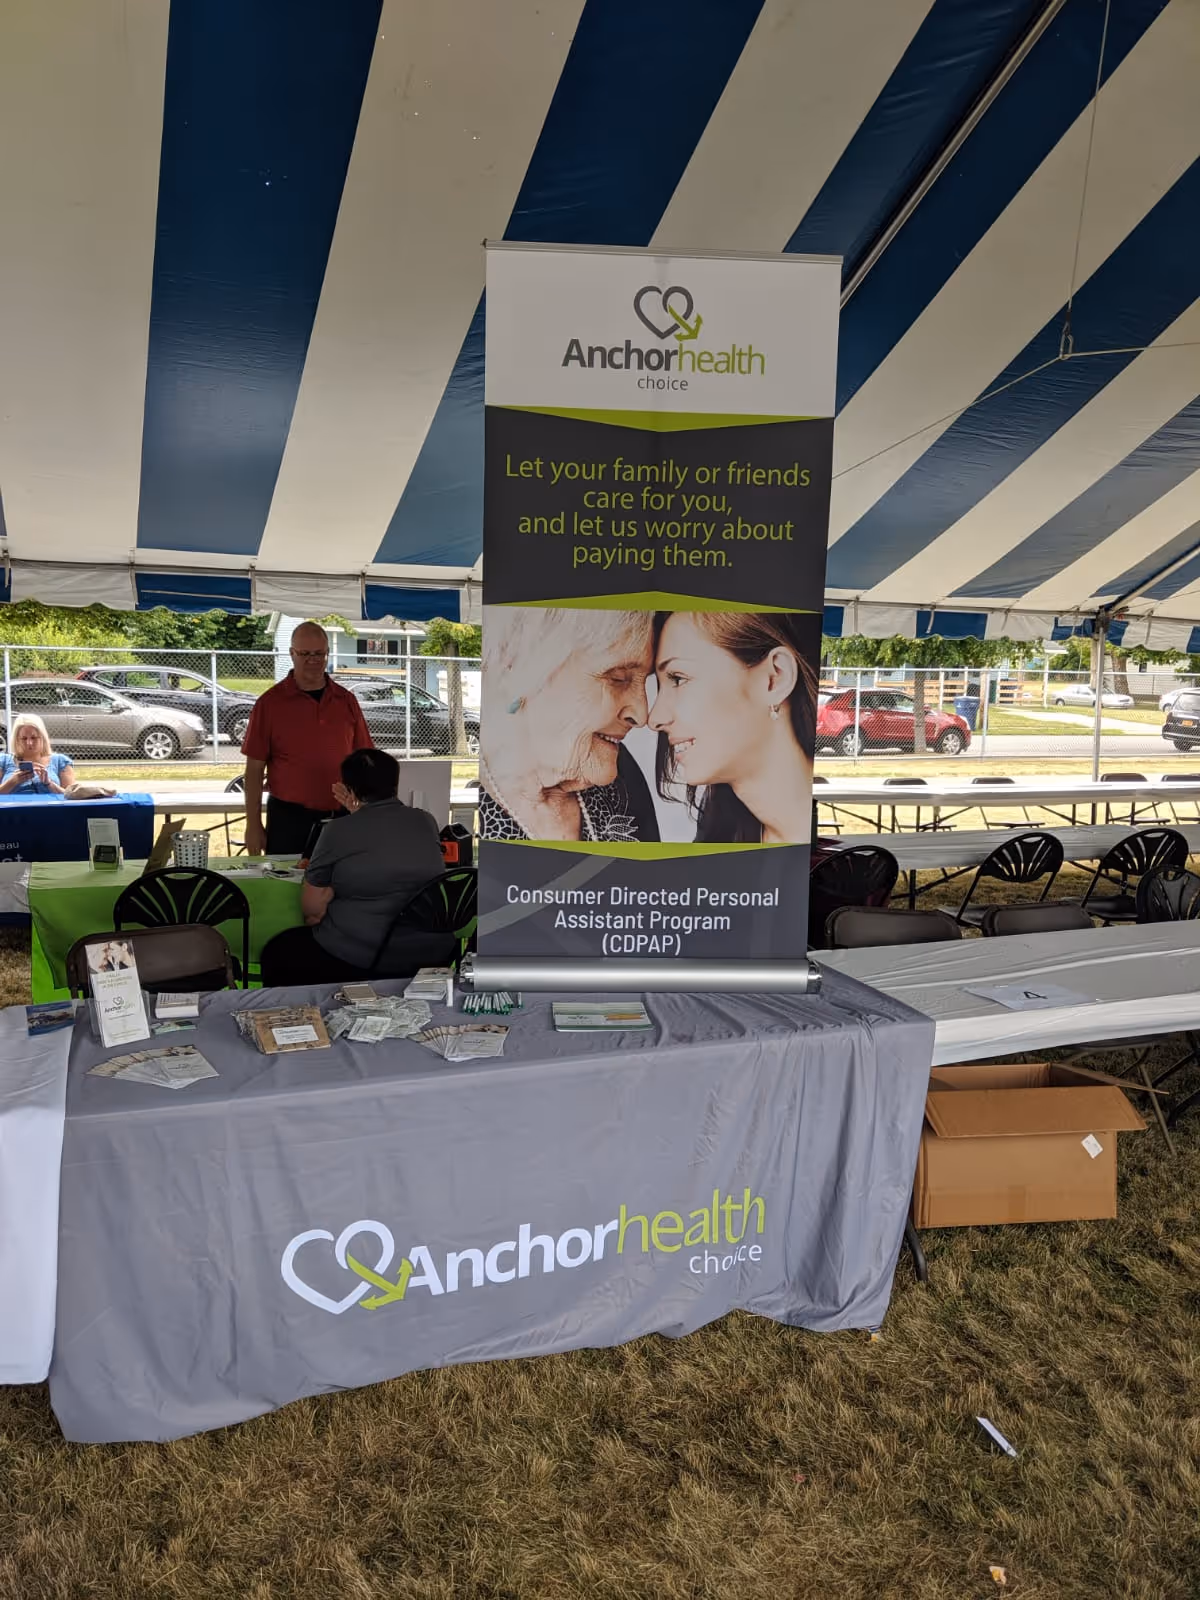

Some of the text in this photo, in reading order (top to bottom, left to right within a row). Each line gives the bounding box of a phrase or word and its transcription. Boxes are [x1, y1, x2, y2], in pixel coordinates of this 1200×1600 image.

[561, 338, 766, 375] Anchorhealth
[637, 376, 689, 391] choice
[505, 454, 811, 489] Let your family or friends
[583, 486, 733, 517] care for you,
[518, 511, 794, 545] and let us worry about
[572, 542, 733, 571] paying them.
[506, 884, 779, 906] Consumer Directed Personal
[554, 909, 731, 934] Assistant Program
[602, 932, 681, 955] (CDPAP)
[405, 1187, 766, 1296] Anchorhealth
[688, 1241, 763, 1274] choice
